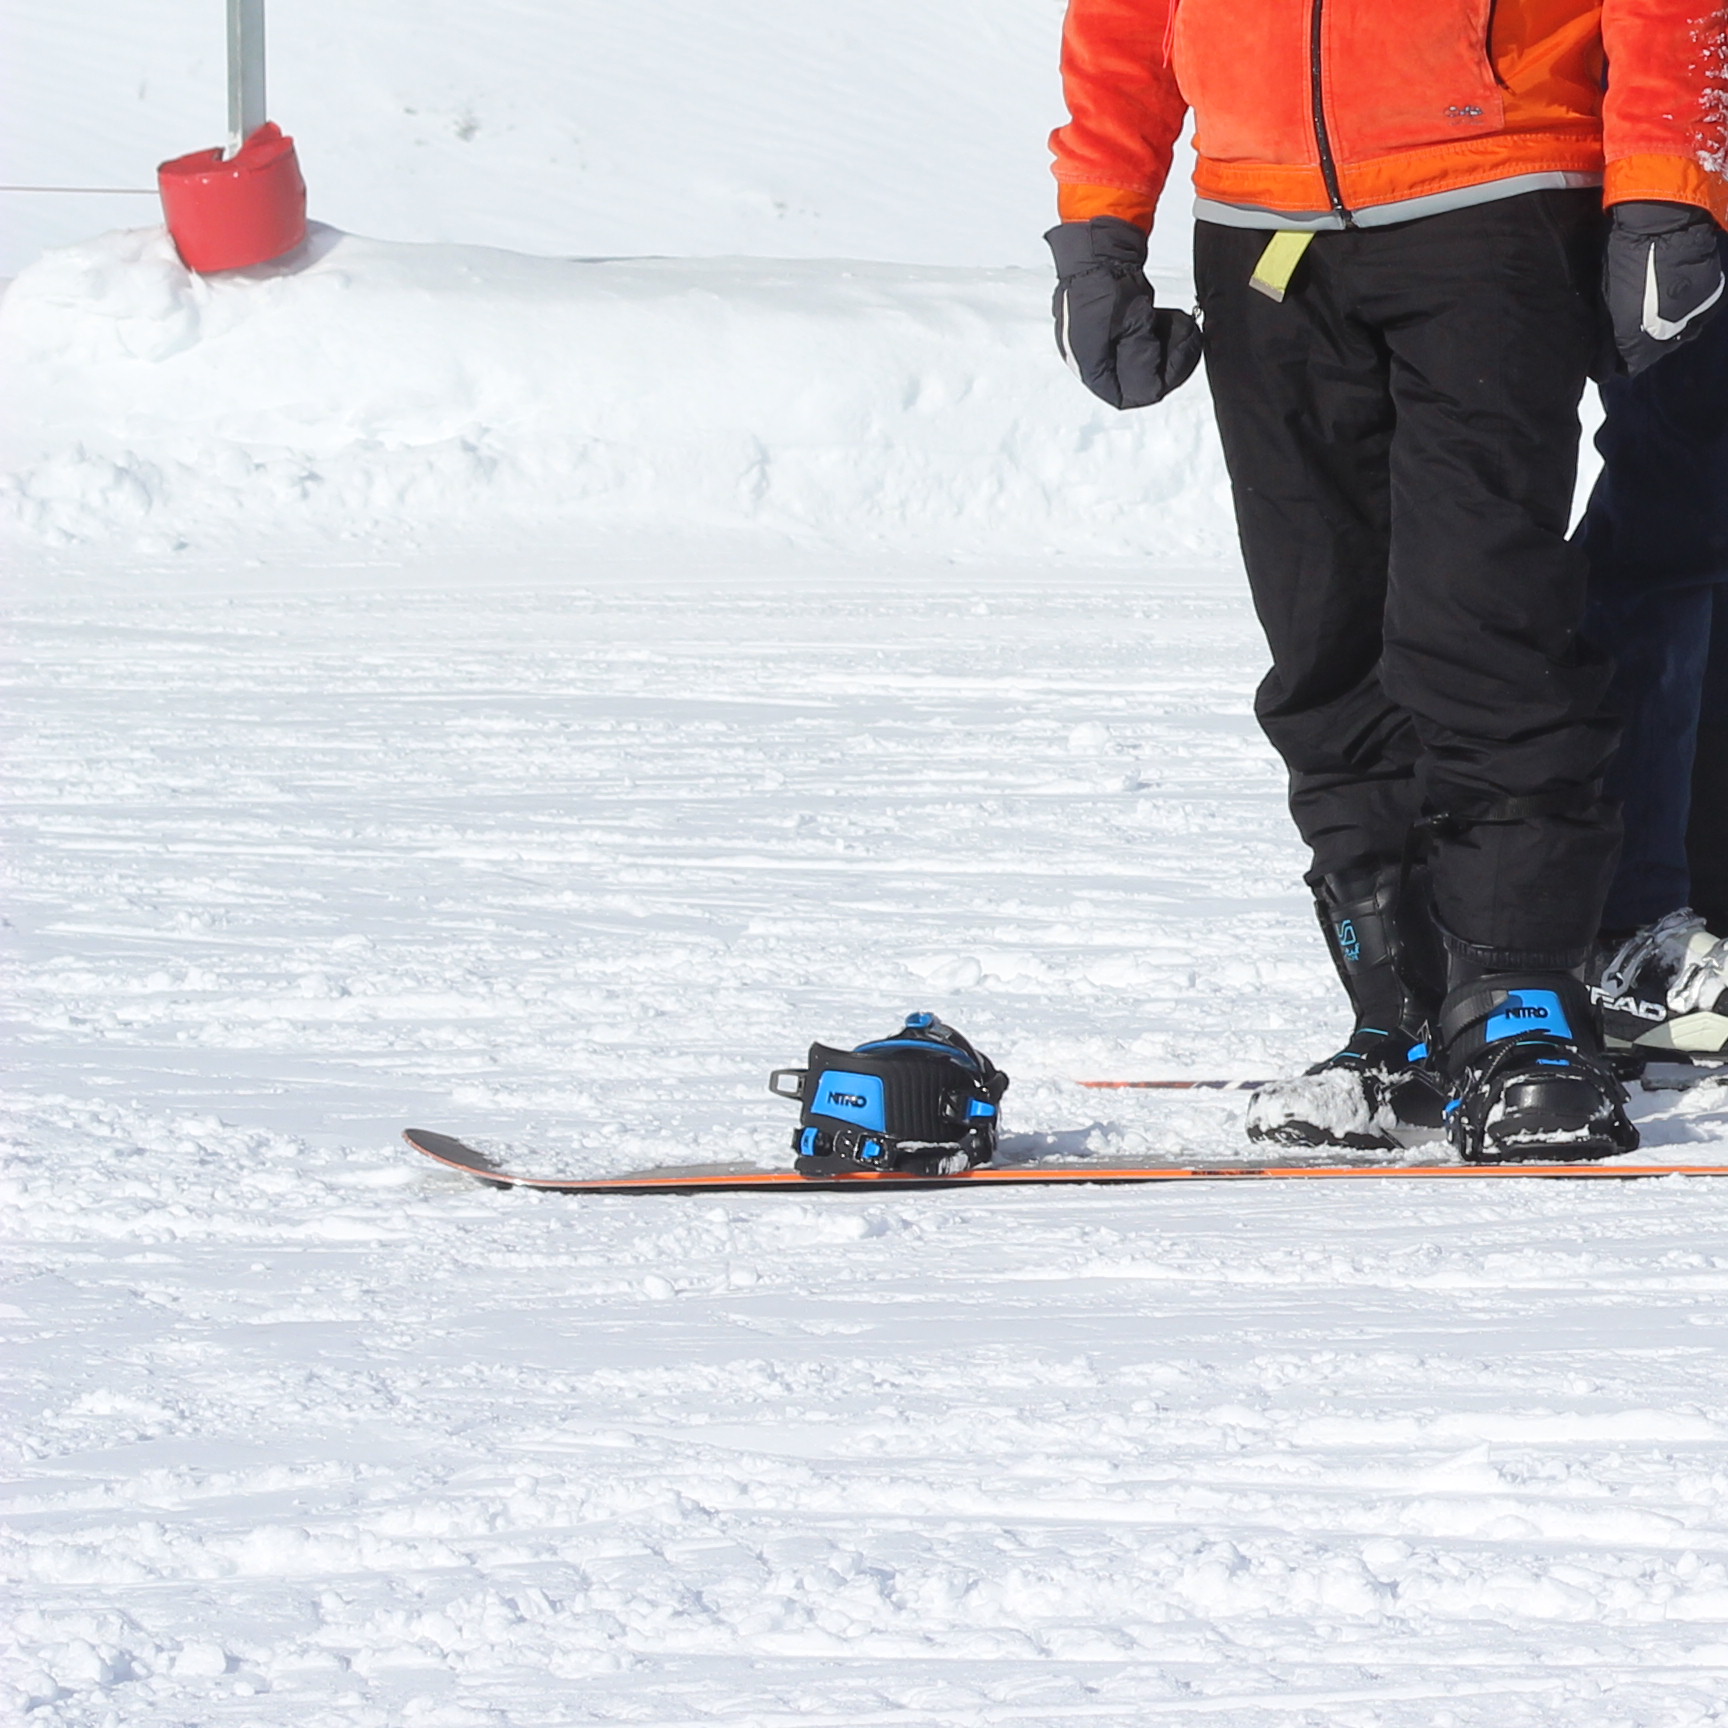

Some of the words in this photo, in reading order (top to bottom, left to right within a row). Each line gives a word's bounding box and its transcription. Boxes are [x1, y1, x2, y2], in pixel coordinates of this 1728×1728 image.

[1585, 985, 1668, 1022] EAD
[1505, 1006, 1549, 1020] NITRO
[827, 1091, 867, 1108] NITRO
